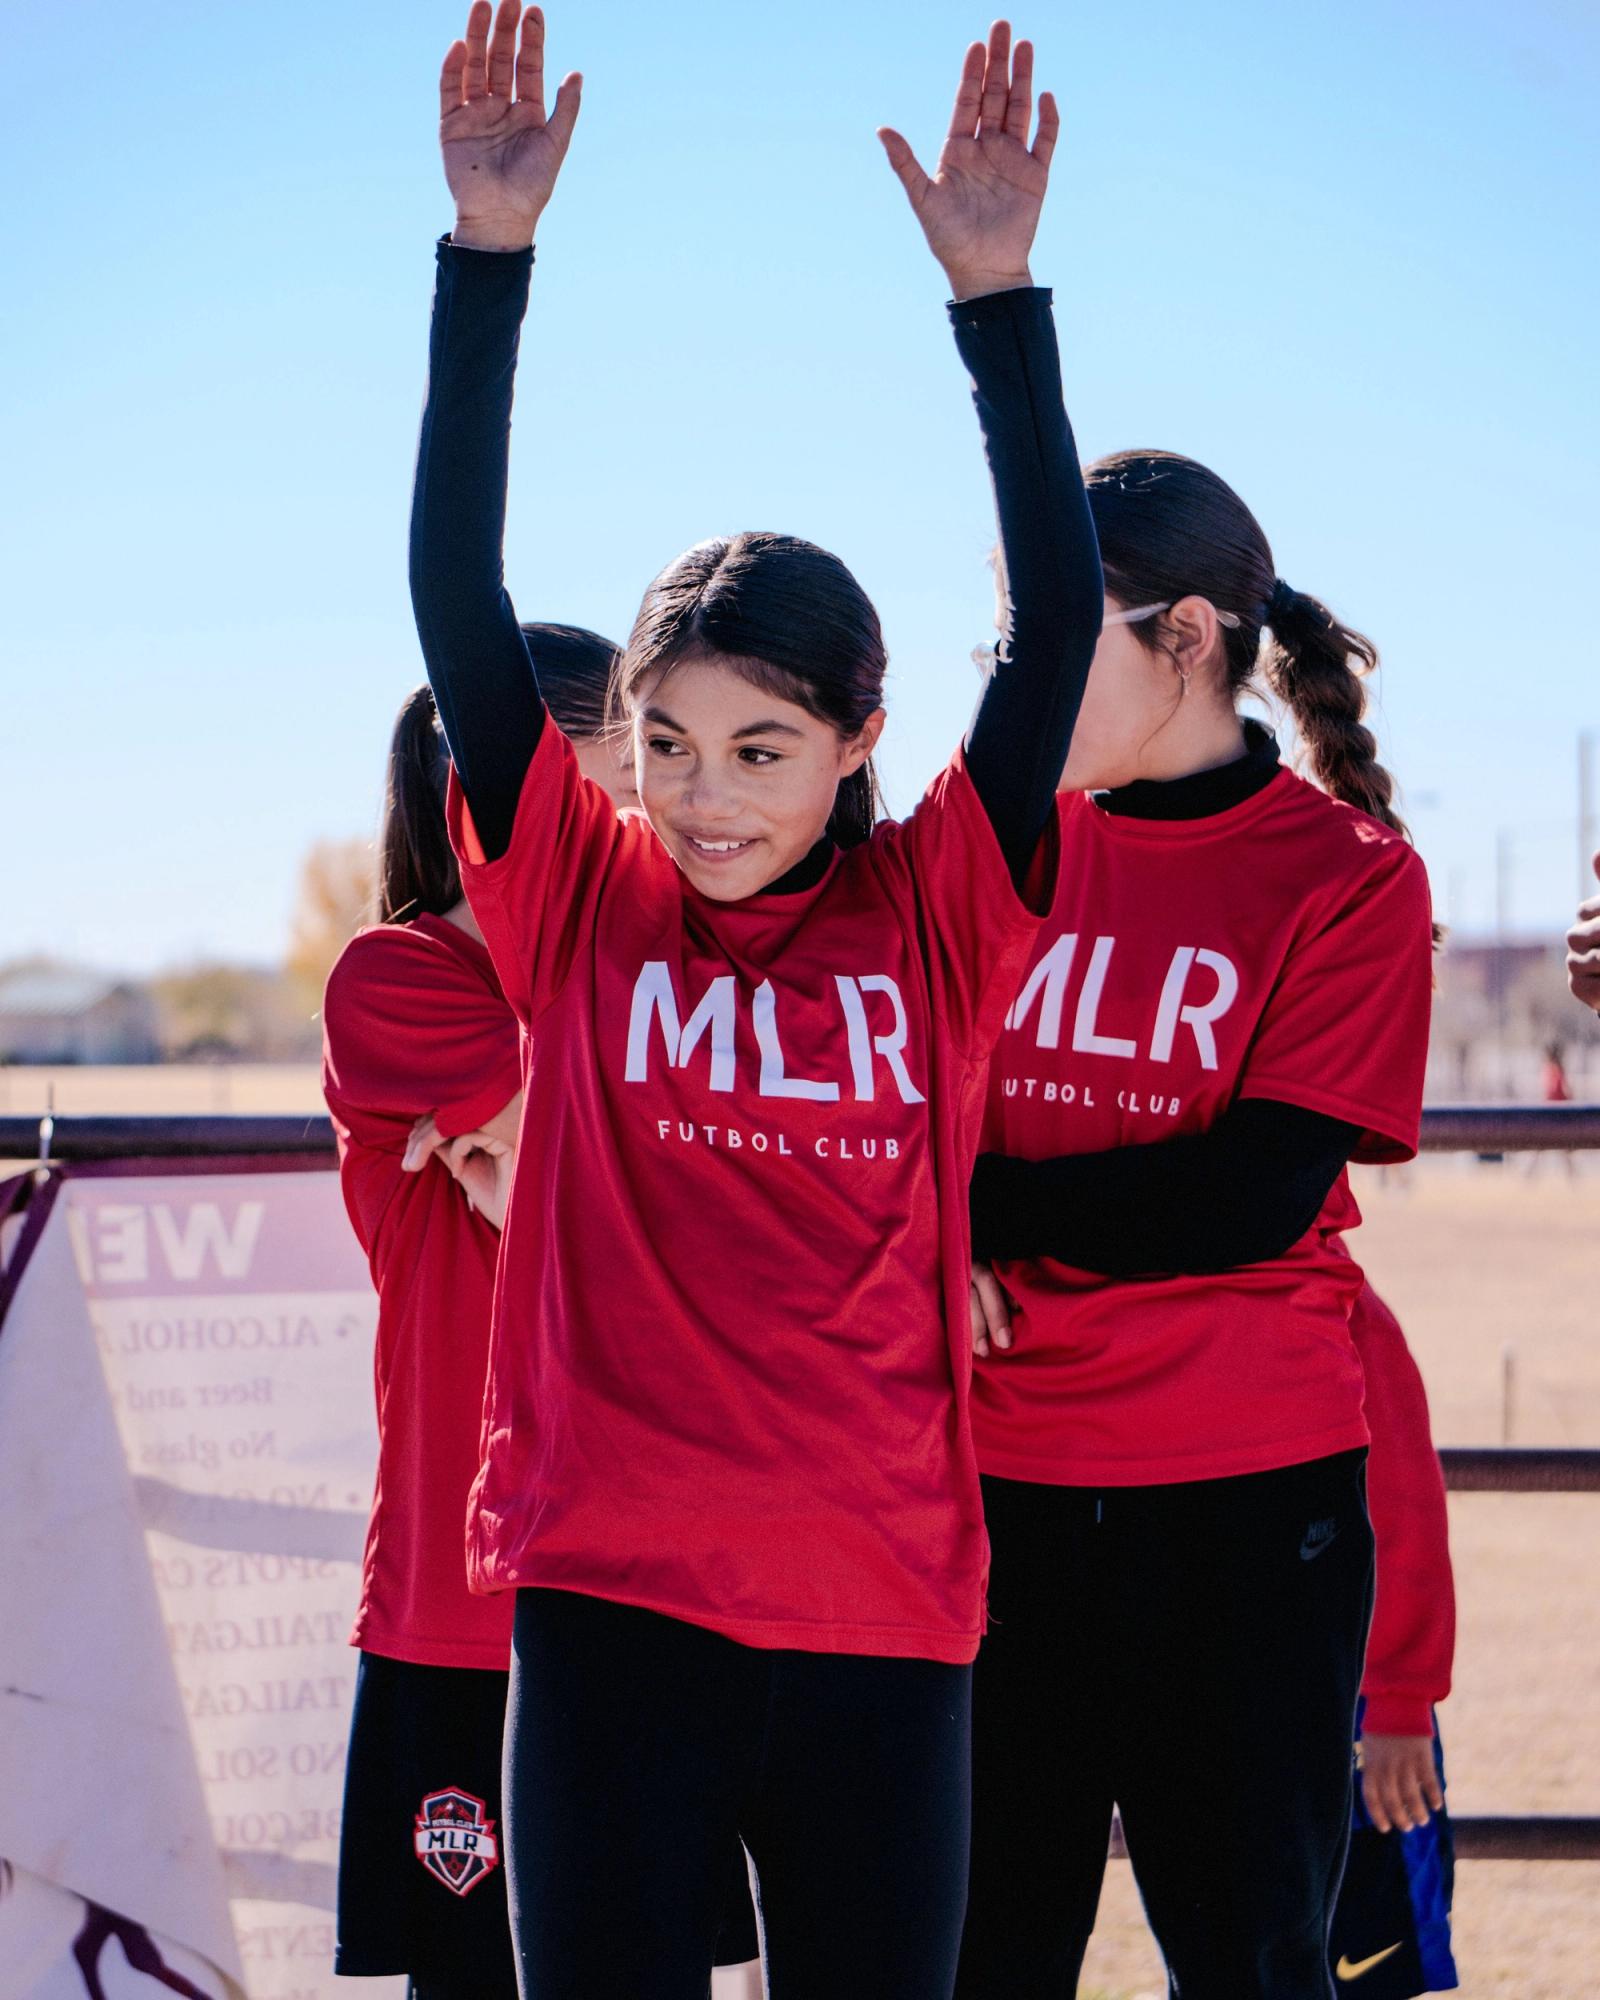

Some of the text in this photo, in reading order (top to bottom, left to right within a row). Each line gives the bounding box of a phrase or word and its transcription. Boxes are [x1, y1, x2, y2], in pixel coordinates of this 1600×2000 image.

[1003, 932, 1240, 1071] MLR
[624, 960, 927, 1104] MLR
[1001, 1078, 1181, 1117] UTBOL CLUB
[657, 1120, 900, 1160] FUTBOL CLUB
[428, 1831, 478, 1851] MLR
